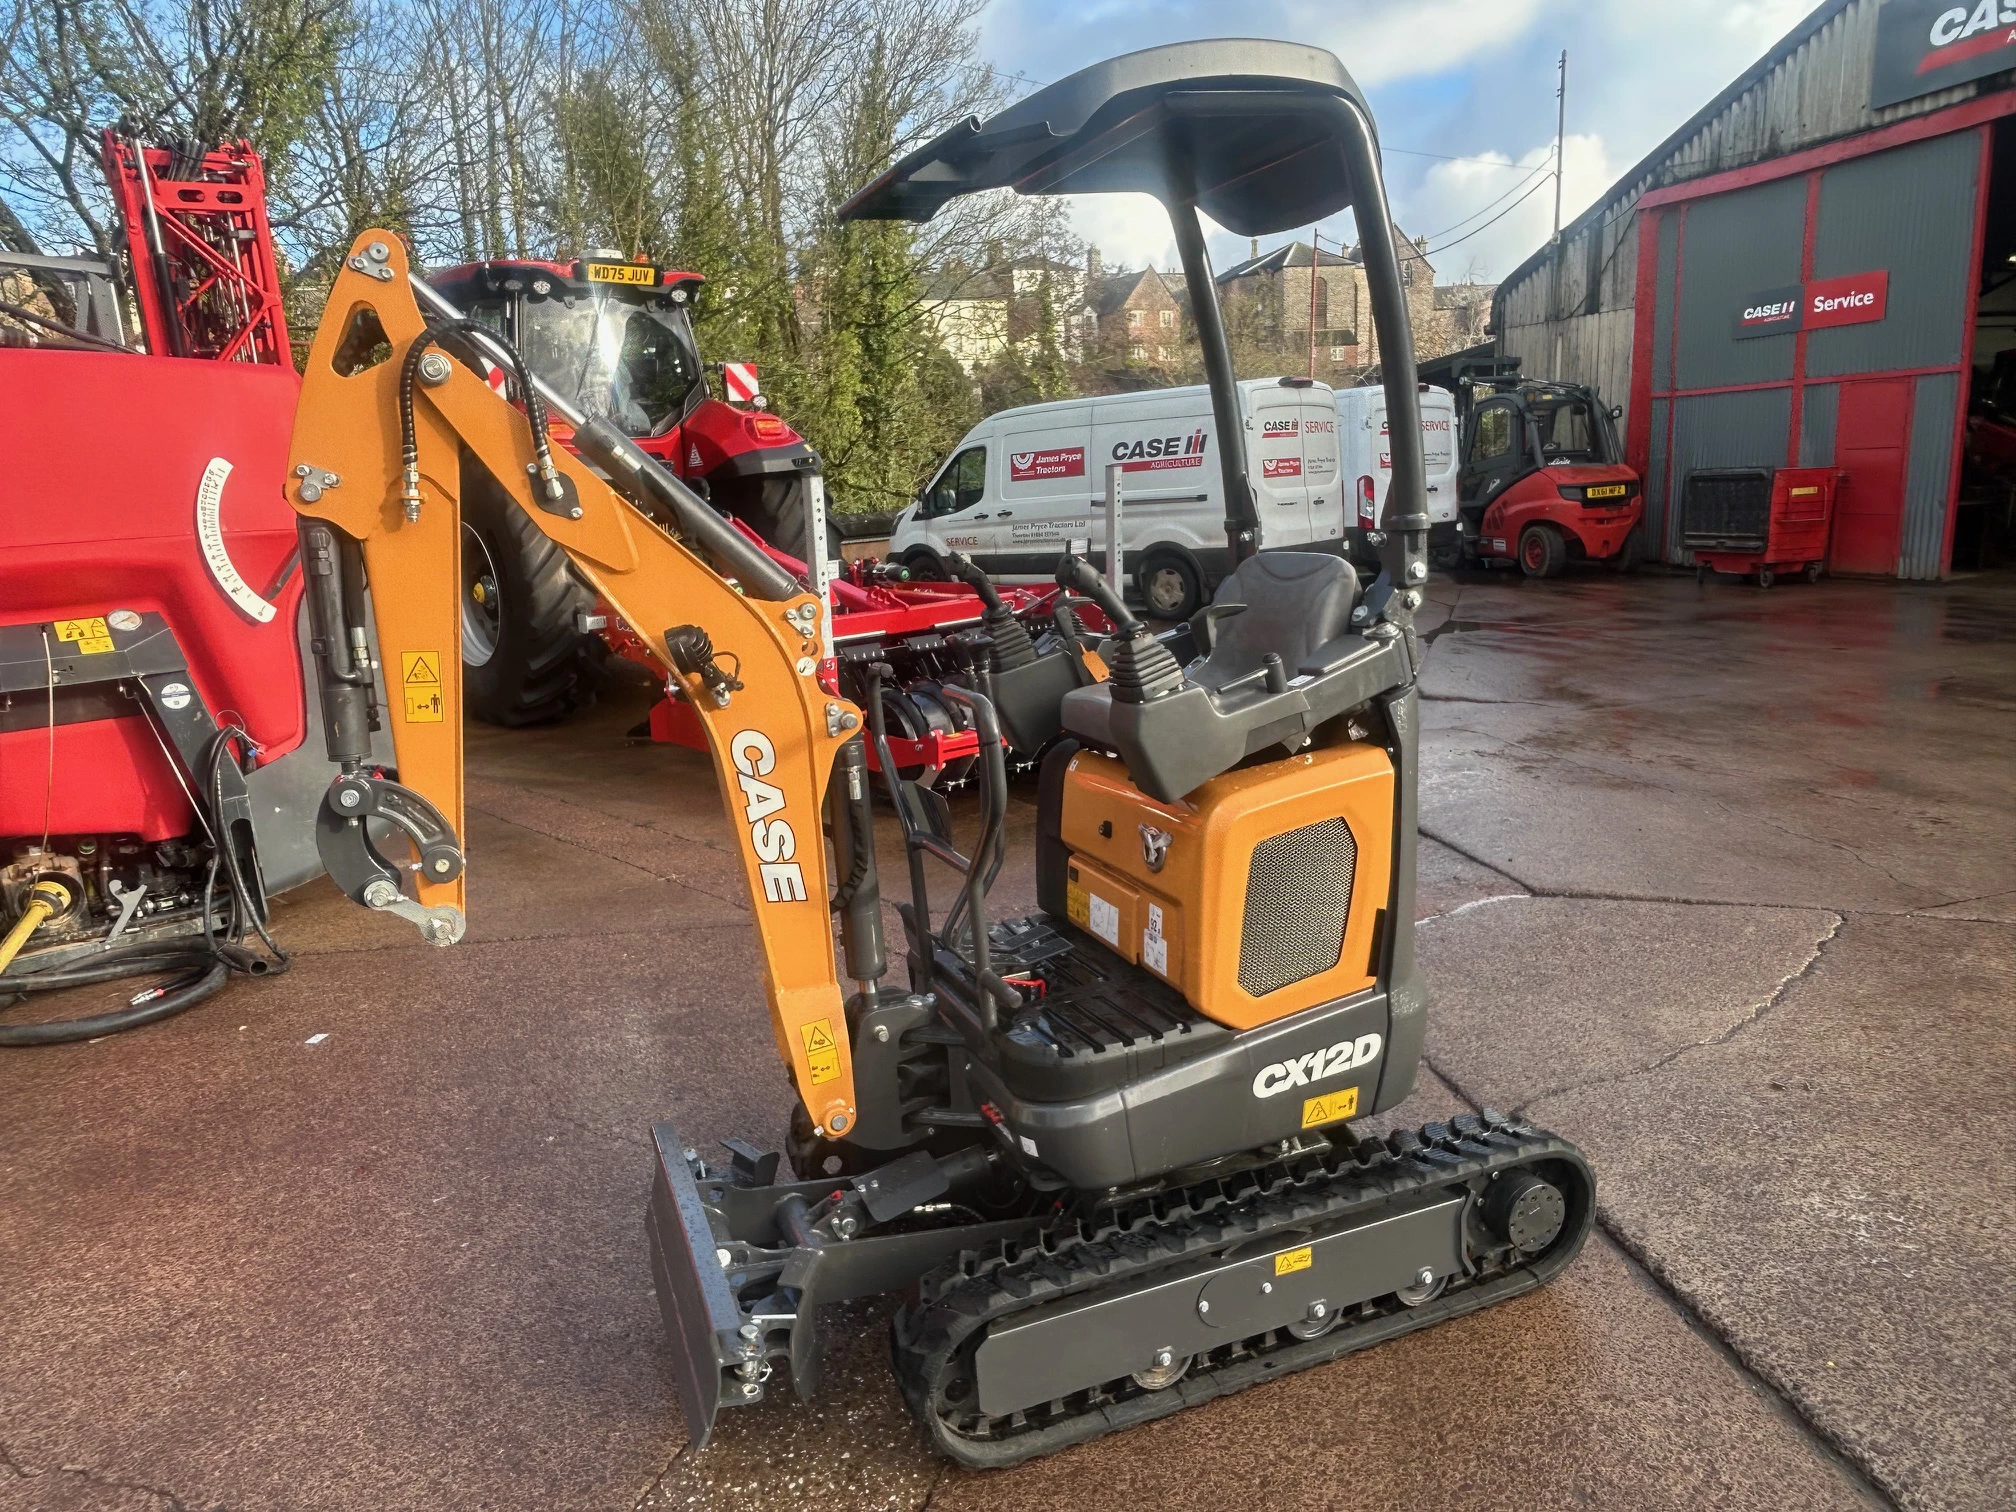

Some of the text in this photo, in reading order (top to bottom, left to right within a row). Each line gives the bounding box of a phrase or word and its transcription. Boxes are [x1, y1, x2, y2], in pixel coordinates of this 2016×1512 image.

[594, 265, 649, 282] WD75 JUV
[1813, 291, 1874, 313] Service
[1743, 303, 1782, 320] CASE
[1264, 420, 1290, 431] CASE
[1305, 421, 1334, 433] SERVICE
[1111, 436, 1181, 461] CASE
[946, 536, 978, 546] SERVICE
[730, 728, 808, 903] CASE
[1252, 1032, 1382, 1099] CX12D
